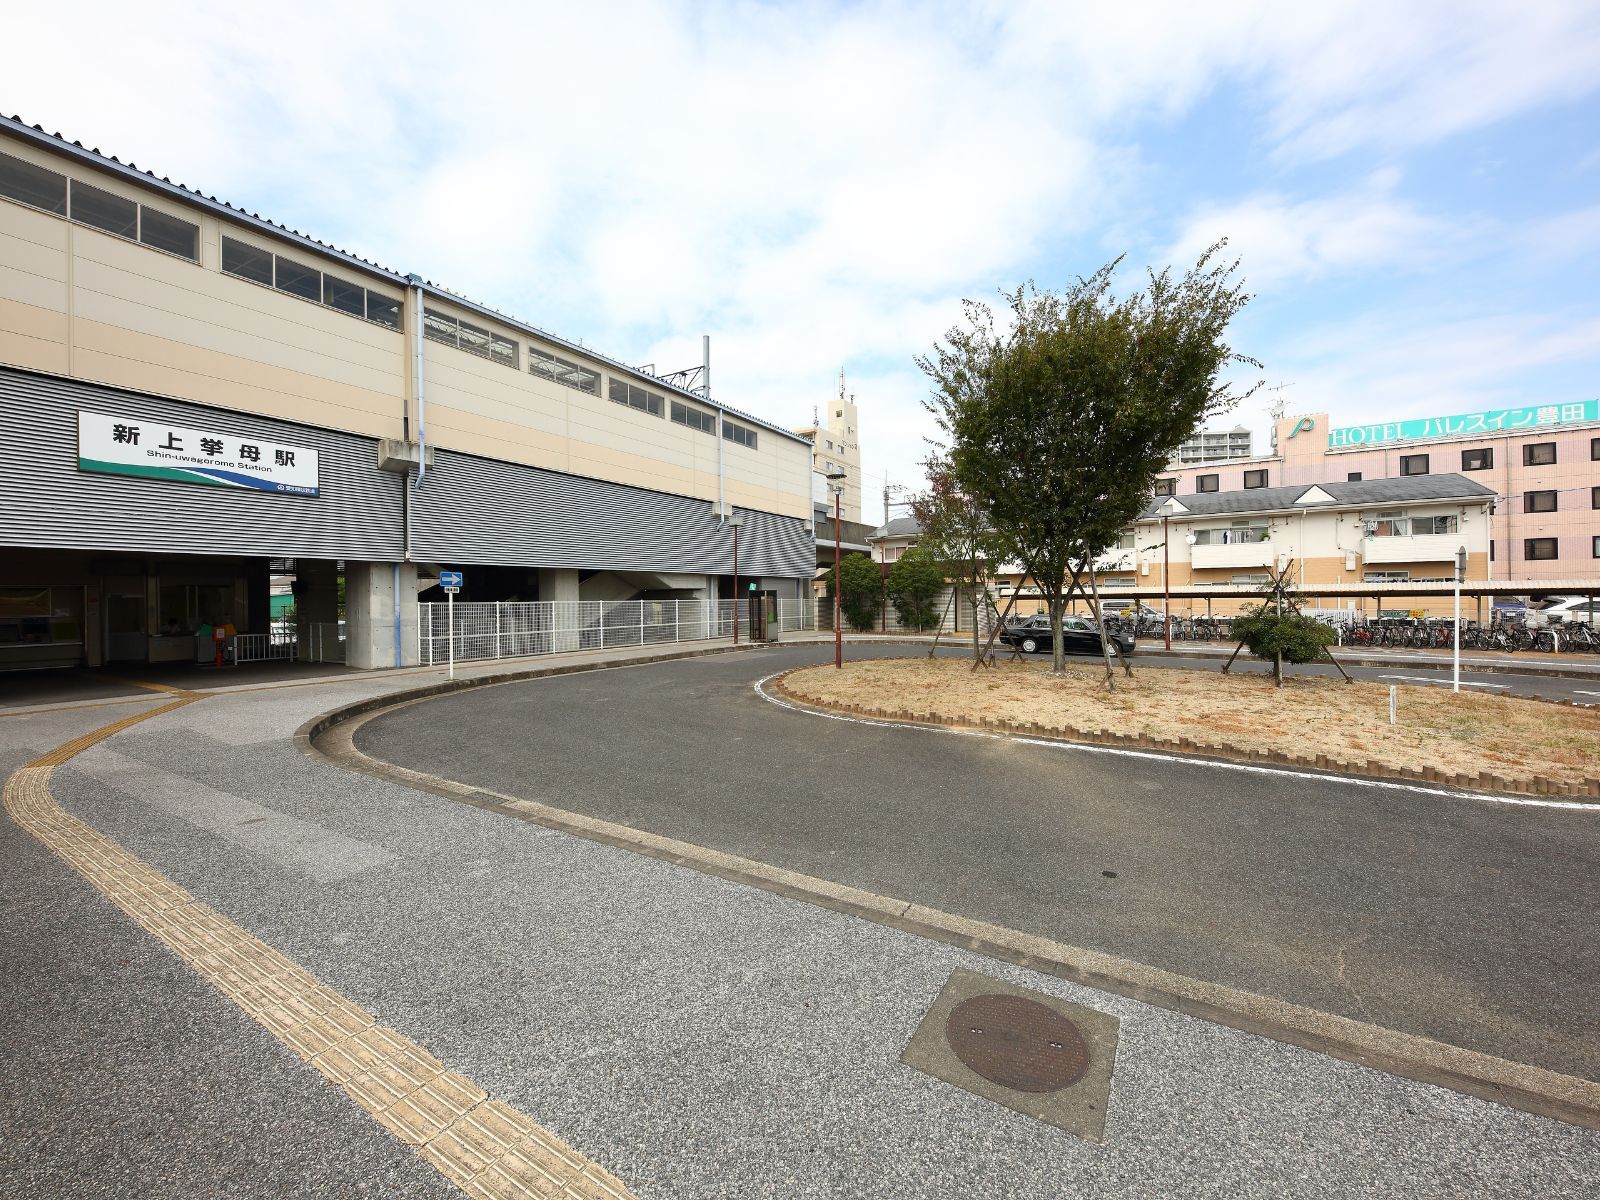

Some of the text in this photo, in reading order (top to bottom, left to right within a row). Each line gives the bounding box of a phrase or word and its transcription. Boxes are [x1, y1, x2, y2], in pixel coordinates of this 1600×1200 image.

[1422, 403, 1585, 436] パレスイン豊田
[112, 423, 296, 468] 新上挙母駅
[1331, 422, 1409, 446] HOTEL
[146, 449, 273, 473] Shin-uwagoromo Station
